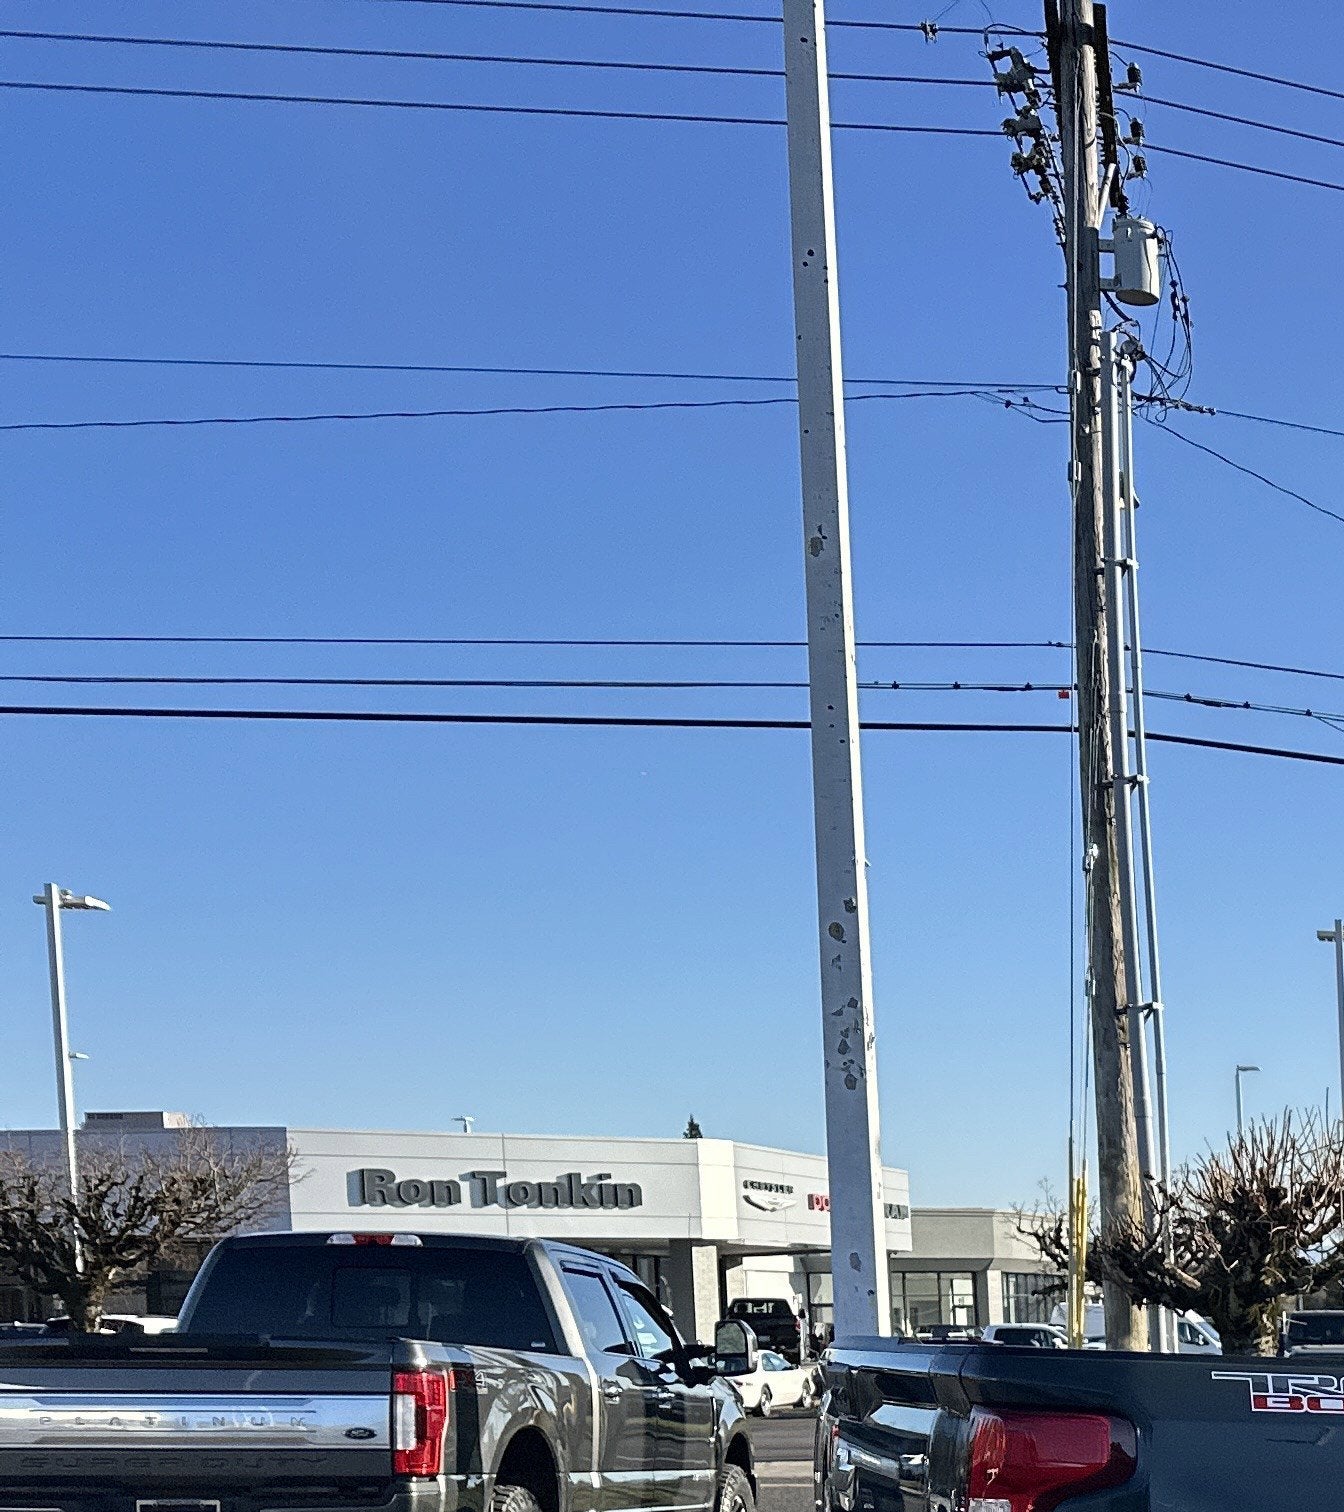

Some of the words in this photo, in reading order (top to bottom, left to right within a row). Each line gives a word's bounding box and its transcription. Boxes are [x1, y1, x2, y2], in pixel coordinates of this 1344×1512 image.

[346, 1168, 462, 1208] Ron
[459, 1170, 643, 1210] Tonkin
[39, 1416, 308, 1427] PLATINUM
